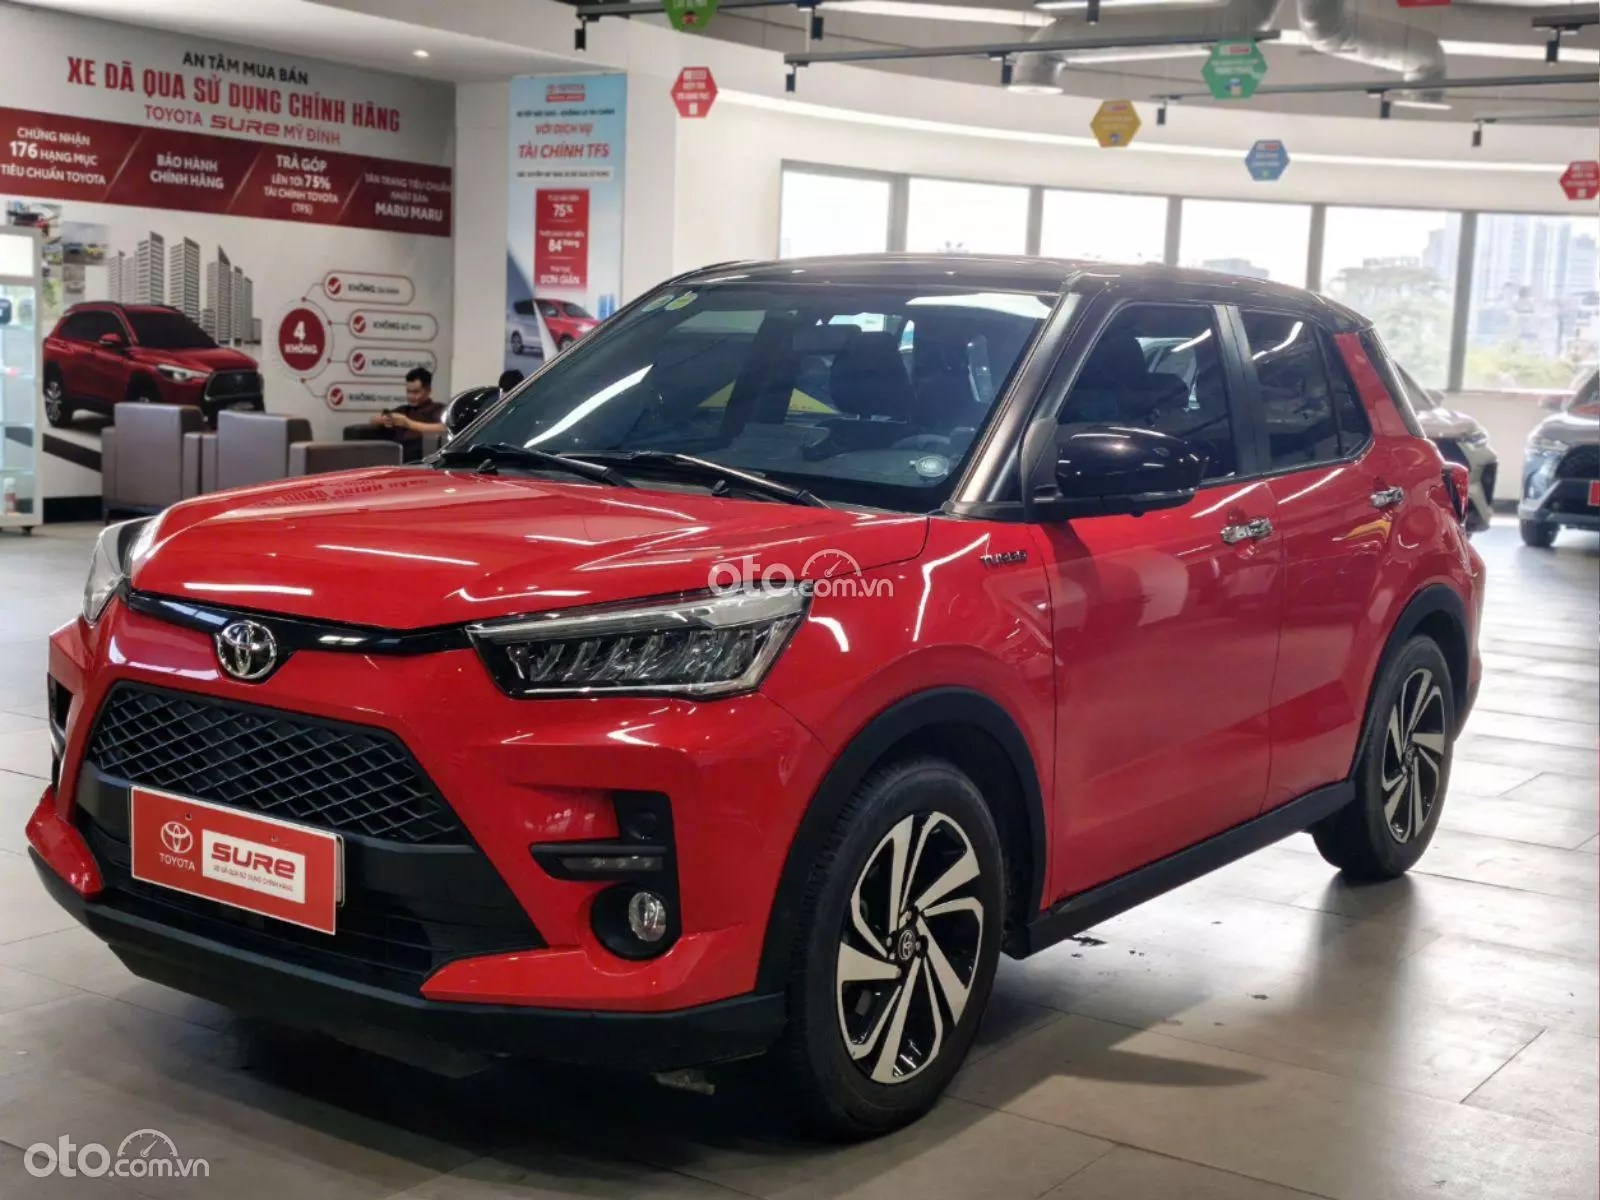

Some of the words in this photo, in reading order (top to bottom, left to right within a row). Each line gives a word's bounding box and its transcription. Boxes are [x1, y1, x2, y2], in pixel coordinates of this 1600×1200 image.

[183, 52, 205, 68] AN
[208, 53, 240, 73] TÂM
[243, 61, 275, 81] MUA
[280, 65, 308, 85] BÁN
[67, 56, 96, 86] XE
[143, 69, 185, 100] QUA
[194, 75, 222, 105] SỬ
[228, 82, 282, 114] DỤNG
[289, 91, 345, 124] CHÍNH
[144, 104, 203, 126] TOYOTA
[17, 126, 57, 142] CHỨNG
[10, 140, 38, 159] 176
[40, 149, 72, 163] HẠNG
[74, 153, 98, 168] MỤC
[157, 151, 181, 168] BẢO
[587, 143, 610, 158] TFS
[276, 152, 299, 169] TRẢ
[301, 156, 327, 172] GÓP
[66, 171, 107, 185] TOYOTA
[149, 169, 188, 184] CHÍNH
[304, 174, 332, 190] 75%
[375, 202, 410, 218] MARU
[411, 206, 443, 222] MARU
[293, 321, 306, 341] 4
[159, 852, 195, 872] TOYOTA
[212, 841, 296, 880] SURE
